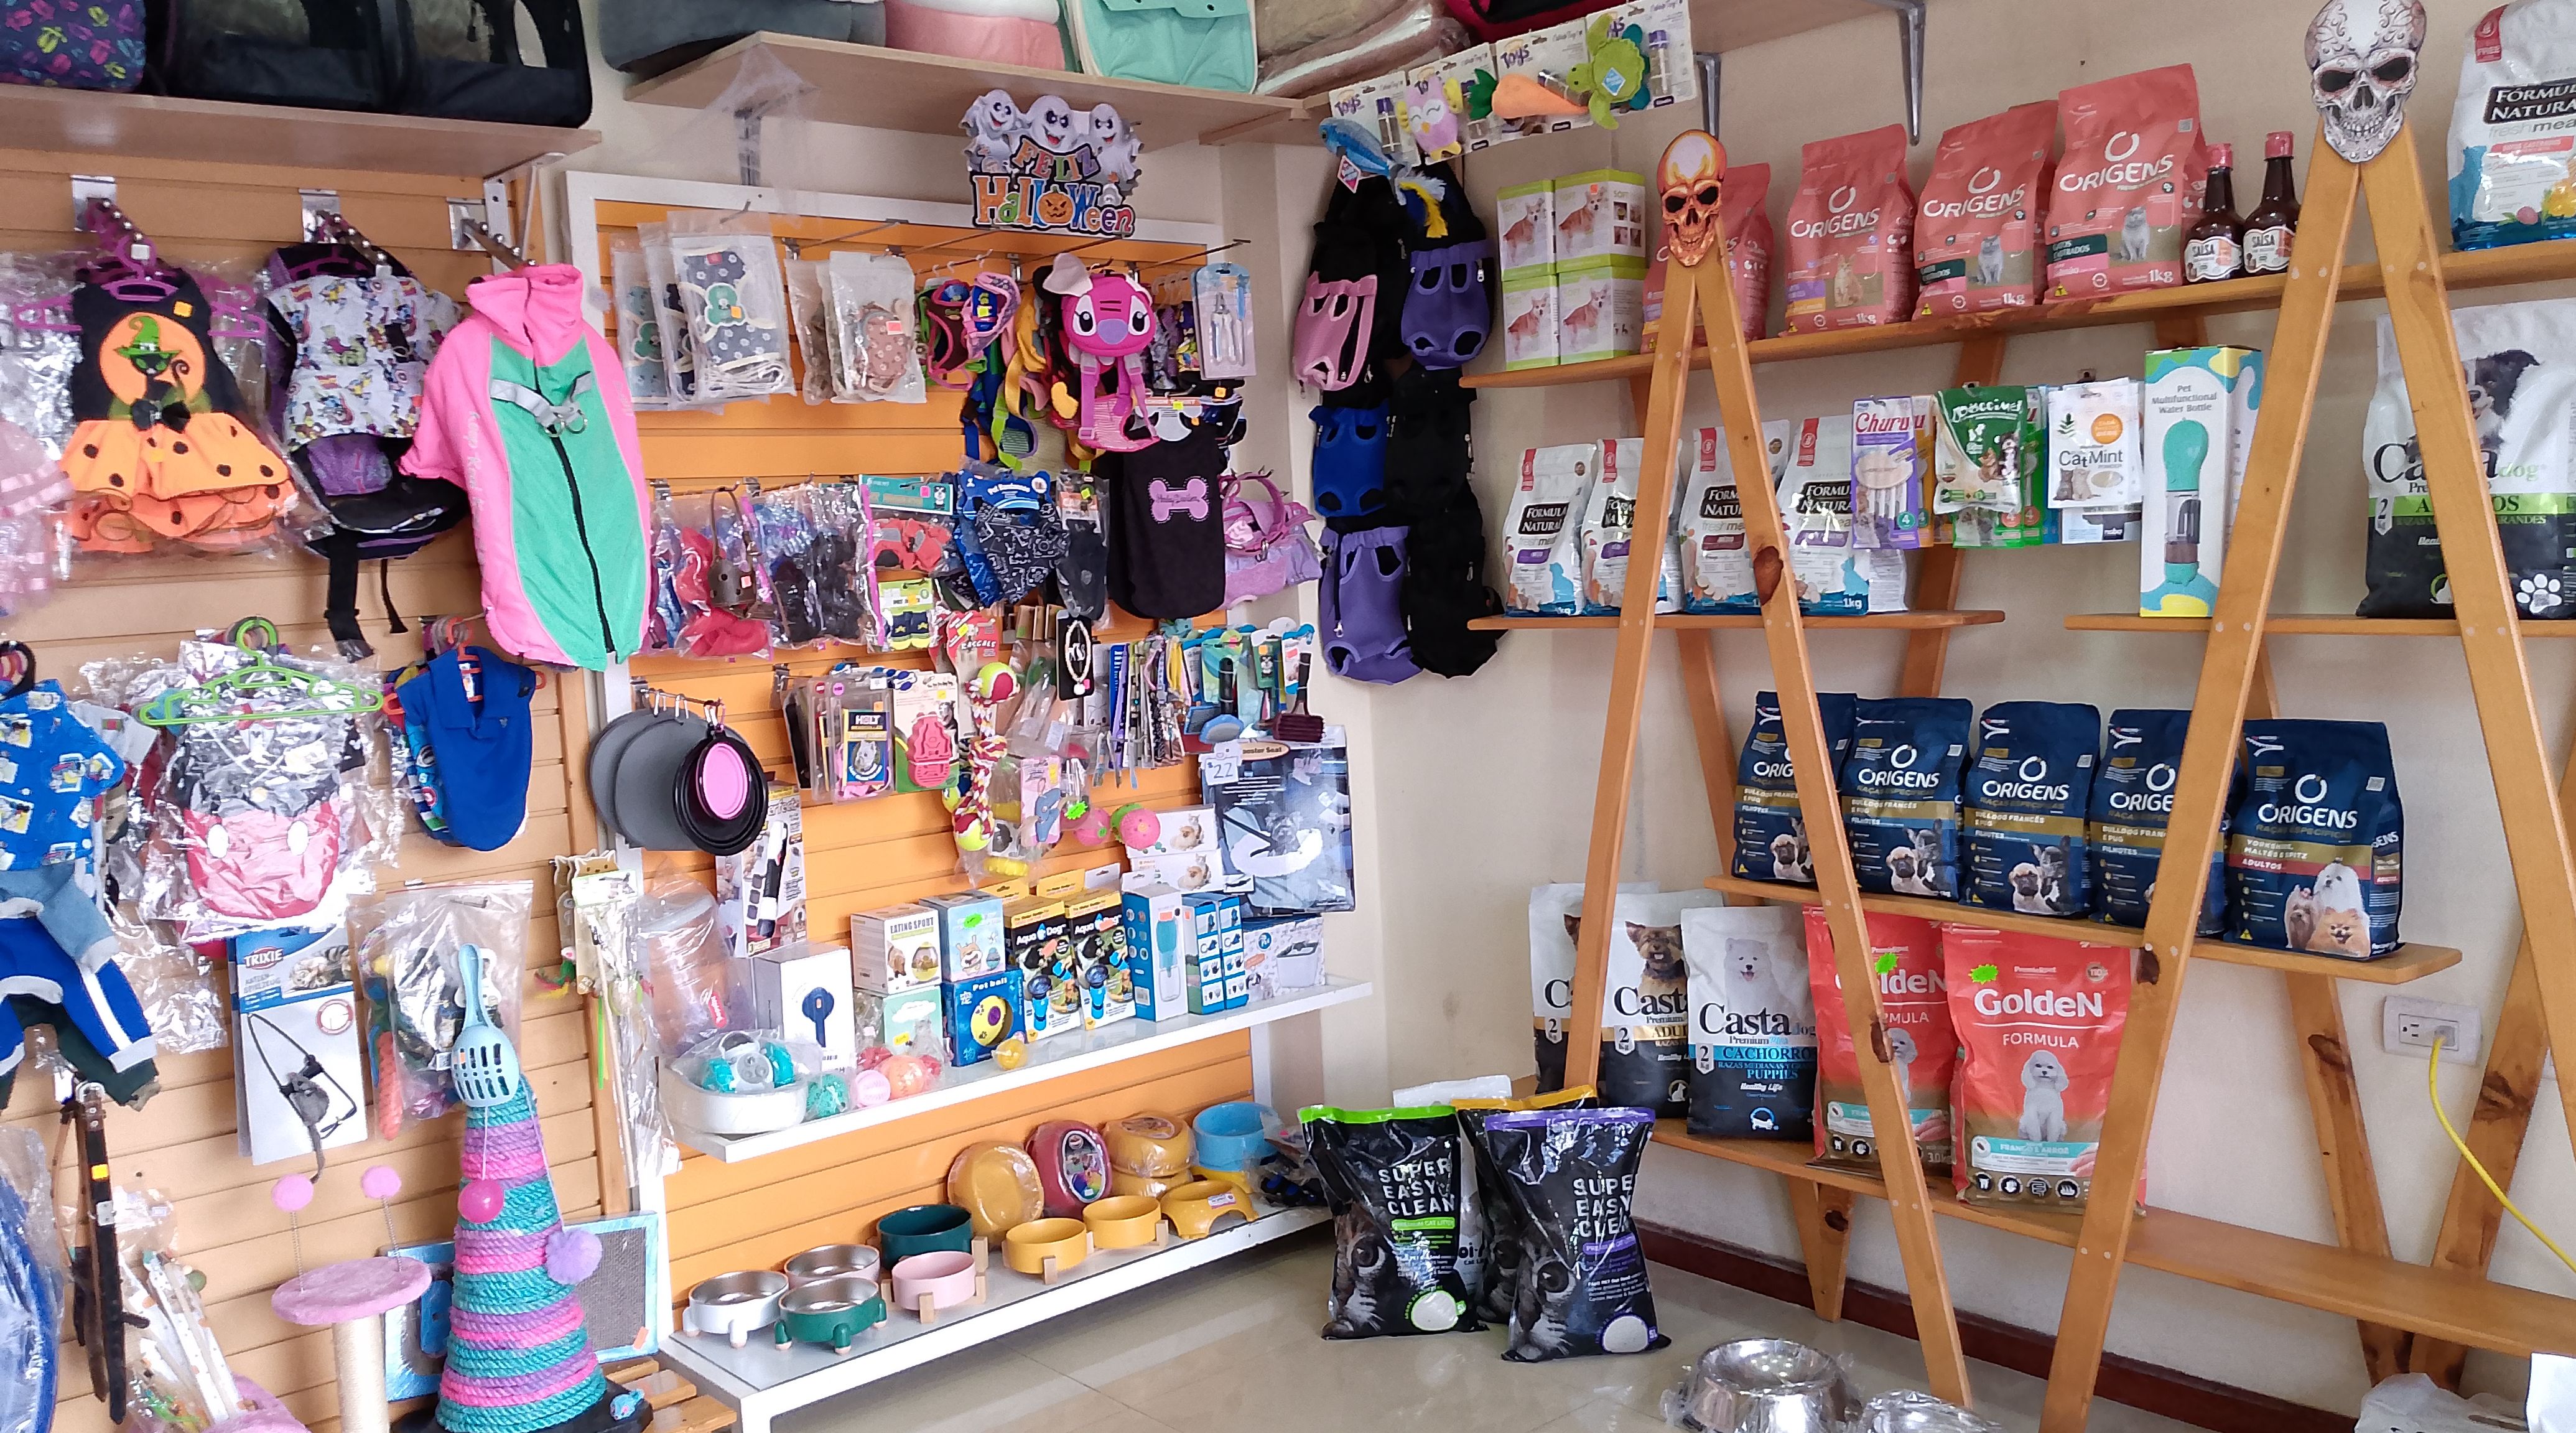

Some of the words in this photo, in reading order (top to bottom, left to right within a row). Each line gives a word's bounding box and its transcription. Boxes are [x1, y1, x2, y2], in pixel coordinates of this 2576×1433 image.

[2496, 83, 2576, 103] FÓRMUL
[2491, 98, 2576, 121] NATURA
[2490, 119, 2576, 139] freshmea
[1012, 137, 1099, 182] FELIZ
[2059, 154, 2174, 192] ORIGENS
[1923, 184, 2026, 218] ORIGENS
[1791, 207, 1881, 238] ORIGENS
[2149, 269, 2174, 283] 1kg
[2002, 292, 2025, 306] 1kg
[1856, 313, 1877, 325] 1kg
[2152, 393, 2217, 404] Multifunctional
[2159, 406, 2183, 414] Water
[2187, 403, 2212, 413] Bottle
[1855, 411, 1910, 432] Churu
[1806, 484, 1851, 497] FÓRMU
[1704, 503, 1742, 516] NATU
[1800, 499, 1852, 511] NATURA
[2378, 498, 2389, 520] 2
[1843, 597, 1863, 610] 1kg
[1753, 761, 1794, 778] ORIG
[1858, 768, 1941, 788] ORIGENS
[1982, 780, 2070, 801] ORIGENS
[2109, 791, 2175, 812] ORIGE
[2257, 803, 2359, 829] ORIGENS
[2139, 829, 2166, 838] FRAN
[2241, 858, 2282, 871] ADULTOS
[890, 922, 912, 934] EATING
[1074, 923, 1094, 935] Aqua
[1016, 936, 1037, 945] Aqua
[244, 948, 284, 968] TRIXIE
[972, 983, 988, 992] Pet
[990, 977, 1007, 988] ball
[1974, 988, 2103, 1017] GoldeN
[1549, 1018, 1558, 1034] 2
[1699, 1002, 1792, 1036] Casta
[1619, 1027, 1629, 1043] 2
[1729, 1035, 1770, 1045] Premium
[2002, 1032, 2080, 1049] FORMULA
[1700, 1045, 1709, 1062] 2
[1377, 1157, 1452, 1183] SUPER
[1382, 1179, 1436, 1200] EASY
[1573, 1175, 1634, 1196] SUPE
[1387, 1193, 1456, 1216] CLEAN
[1576, 1195, 1631, 1216] EASY
